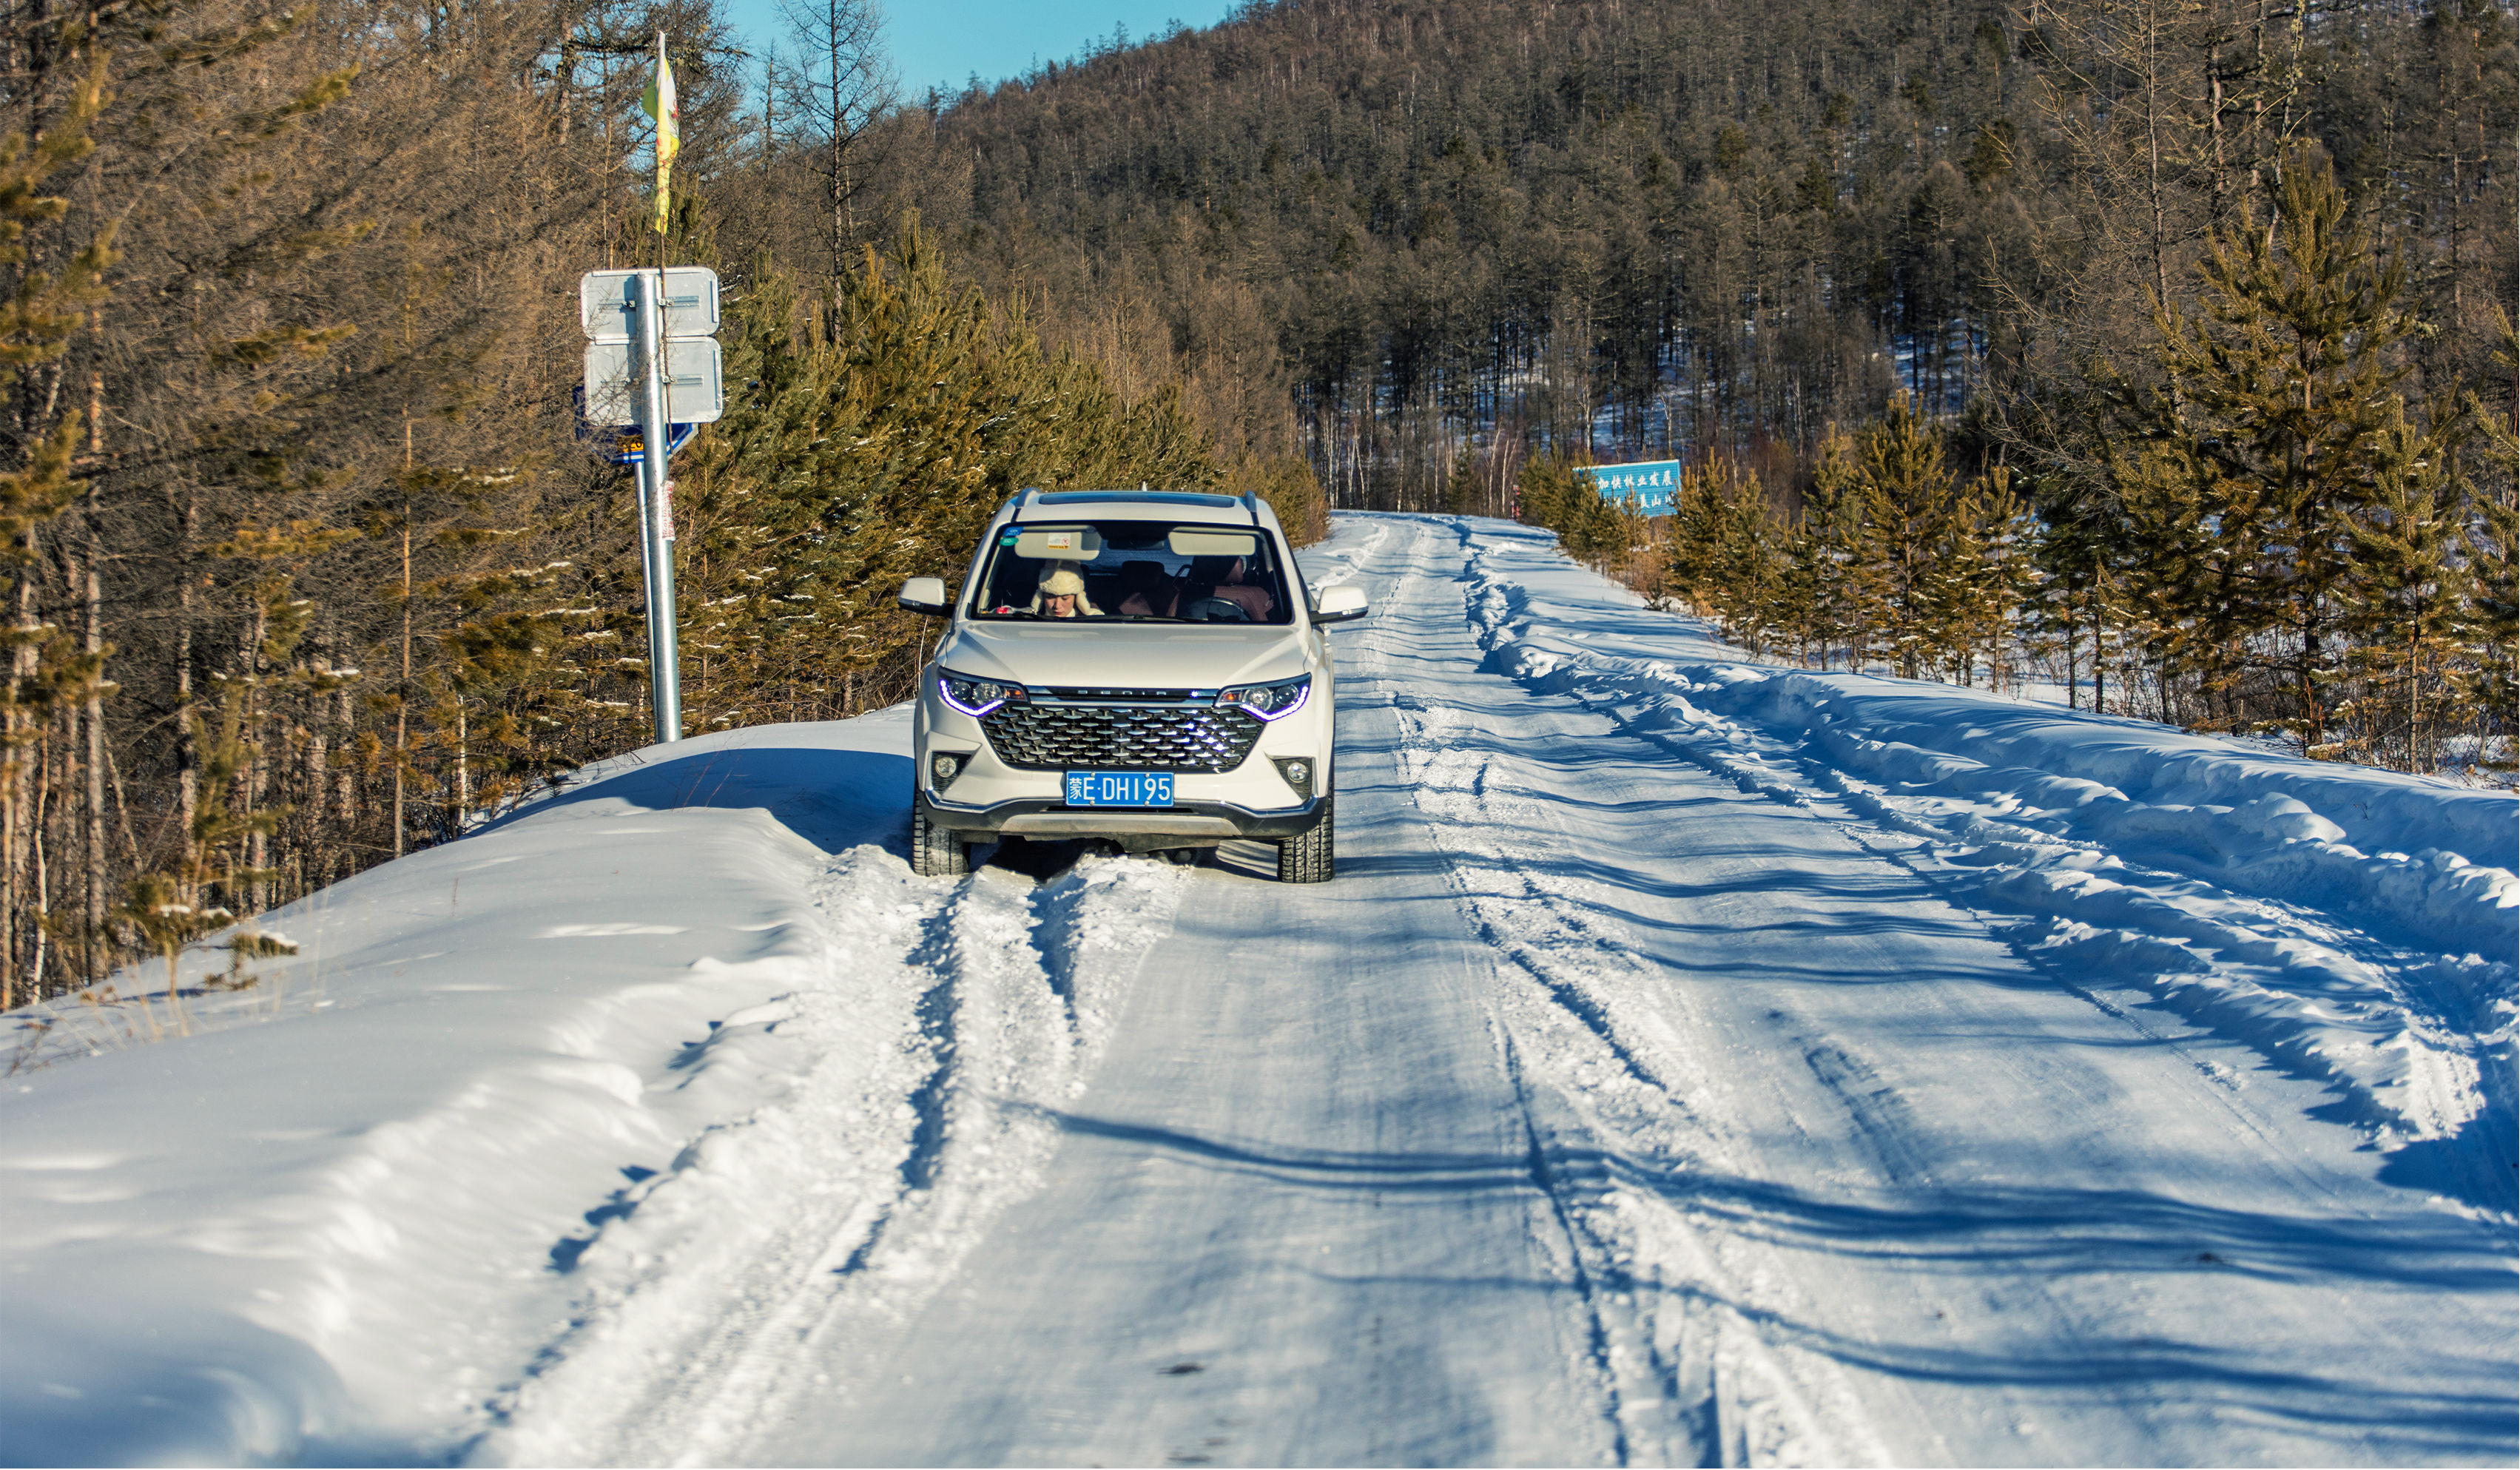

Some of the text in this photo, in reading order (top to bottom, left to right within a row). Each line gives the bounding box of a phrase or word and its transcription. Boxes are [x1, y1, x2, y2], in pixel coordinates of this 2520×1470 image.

[1598, 470, 1672, 490] 加快林业发展
[1069, 777, 1170, 801] 蒙E·DH195
